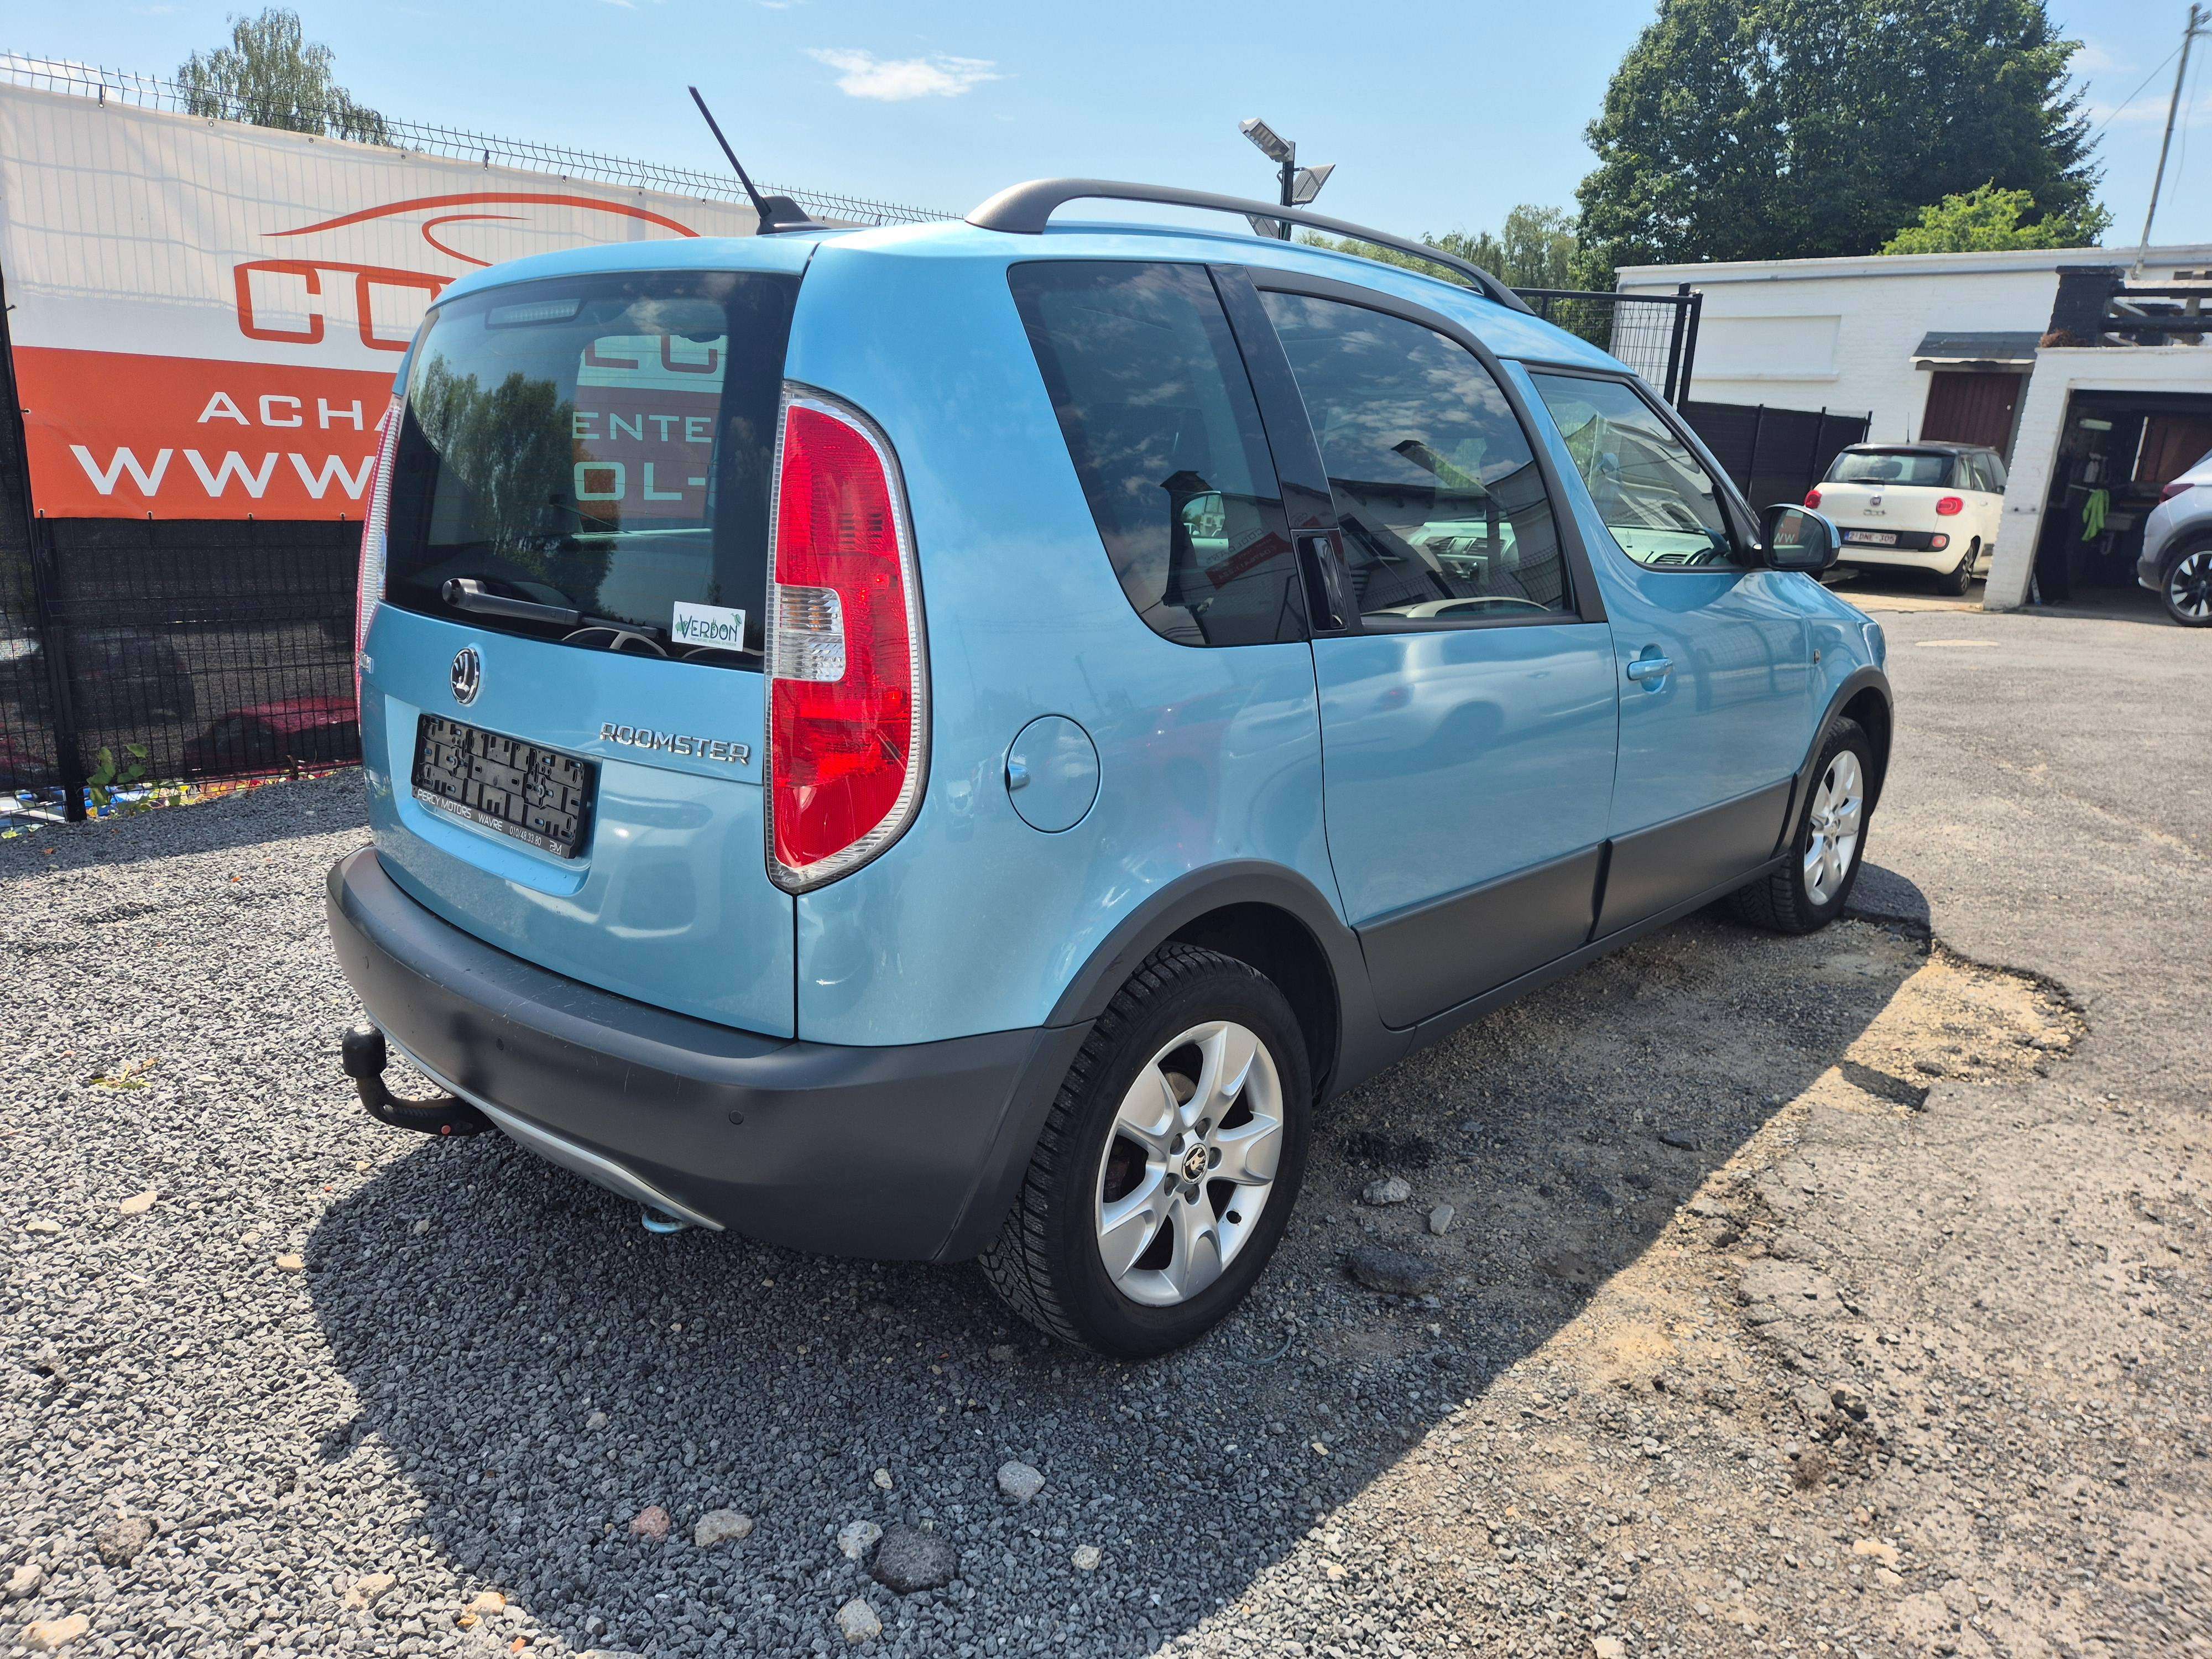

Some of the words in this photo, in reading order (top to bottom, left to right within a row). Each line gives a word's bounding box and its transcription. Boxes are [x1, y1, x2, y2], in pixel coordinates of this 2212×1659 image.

[196, 392, 389, 431] ACH
[572, 411, 712, 443] ENTE
[679, 614, 738, 643] VERDON
[599, 721, 750, 766] ROOMSTER
[418, 789, 441, 806] PERCY
[441, 800, 472, 819] MOTORS
[478, 813, 503, 832] WAVRE
[510, 826, 541, 846] 010/48.33.80
